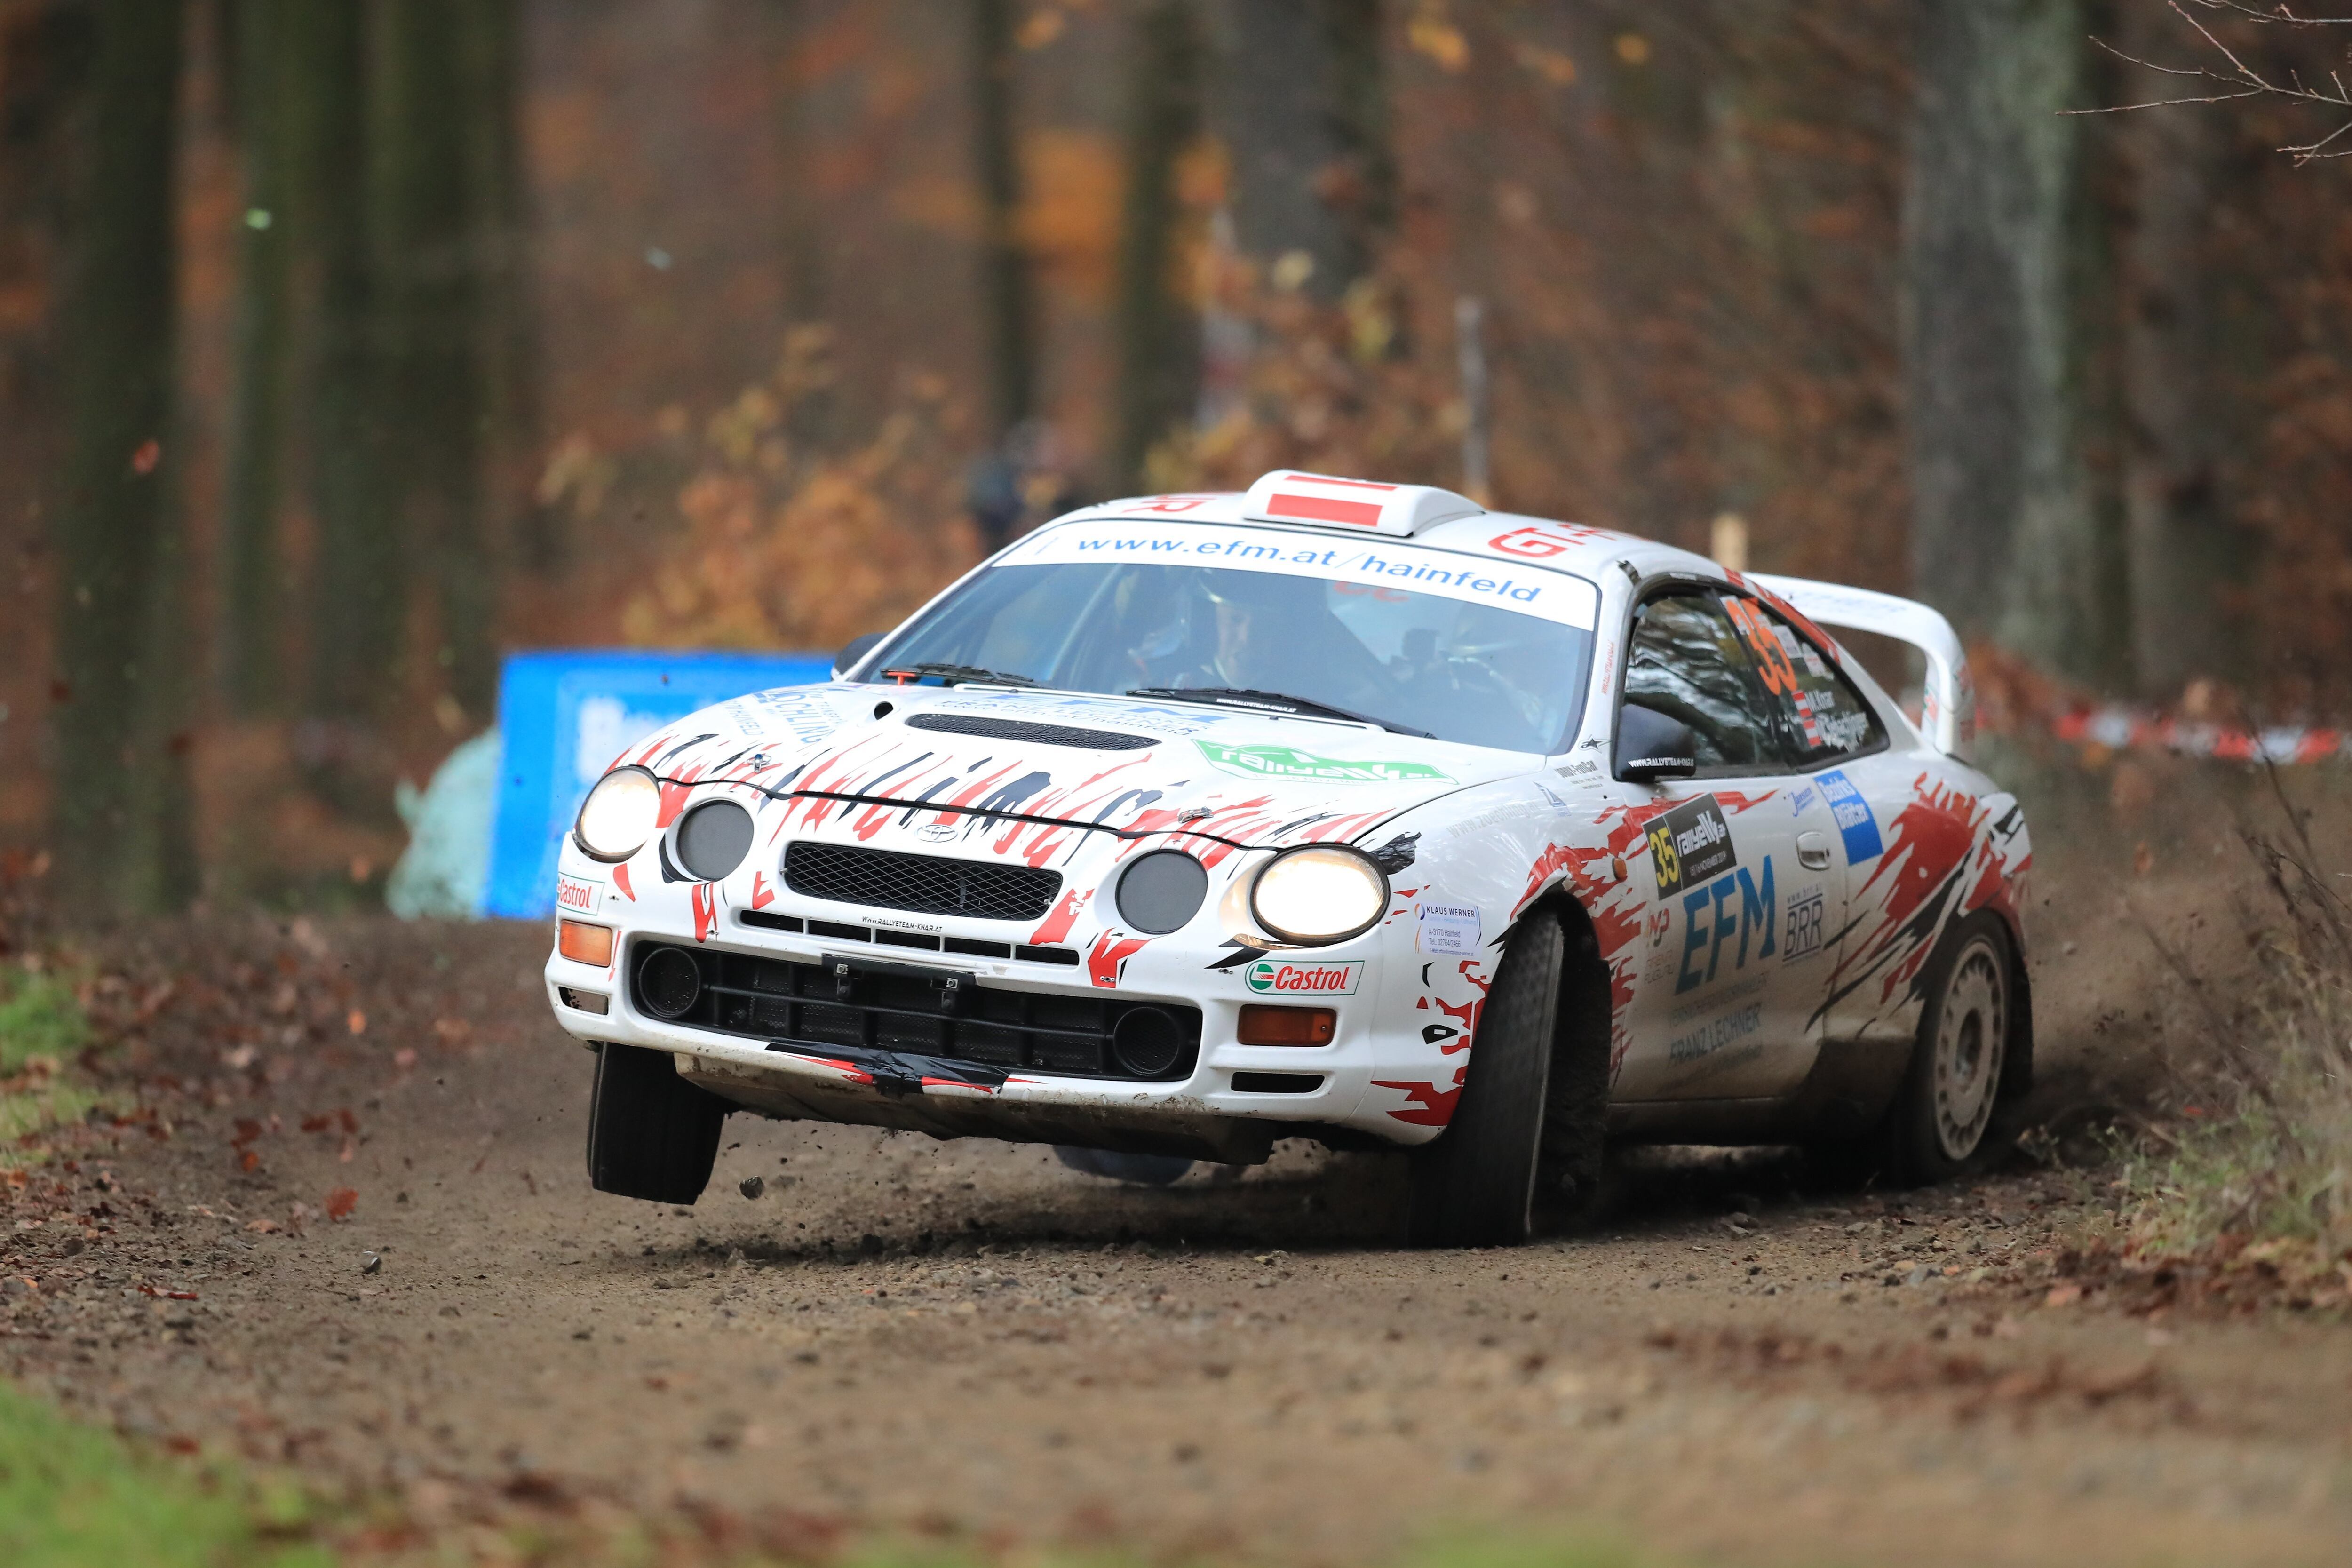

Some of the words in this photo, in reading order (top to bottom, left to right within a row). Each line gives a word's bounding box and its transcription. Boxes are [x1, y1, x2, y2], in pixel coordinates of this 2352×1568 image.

[1078, 540, 1542, 602] www.efm.at/hainfeld
[1725, 597, 1797, 695] 35
[941, 700, 1047, 711] FRANZ
[1054, 709, 1200, 733] LECHNER
[982, 695, 1231, 724] EFM
[1649, 827, 1678, 887] 35
[560, 878, 592, 908] Castrol
[1426, 906, 1447, 915] KLAUS
[1448, 907, 1475, 918] WERNER
[1675, 854, 1776, 996] EFM
[1783, 899, 1823, 956] BRR
[1429, 928, 1444, 936] A-3170
[1445, 930, 1461, 938] Hainfeld
[1438, 939, 1461, 947] 02764/2466
[1275, 966, 1350, 990] Castrol
[1668, 1029, 1708, 1067] FRANZ
[1709, 1002, 1762, 1053] LECHNER
